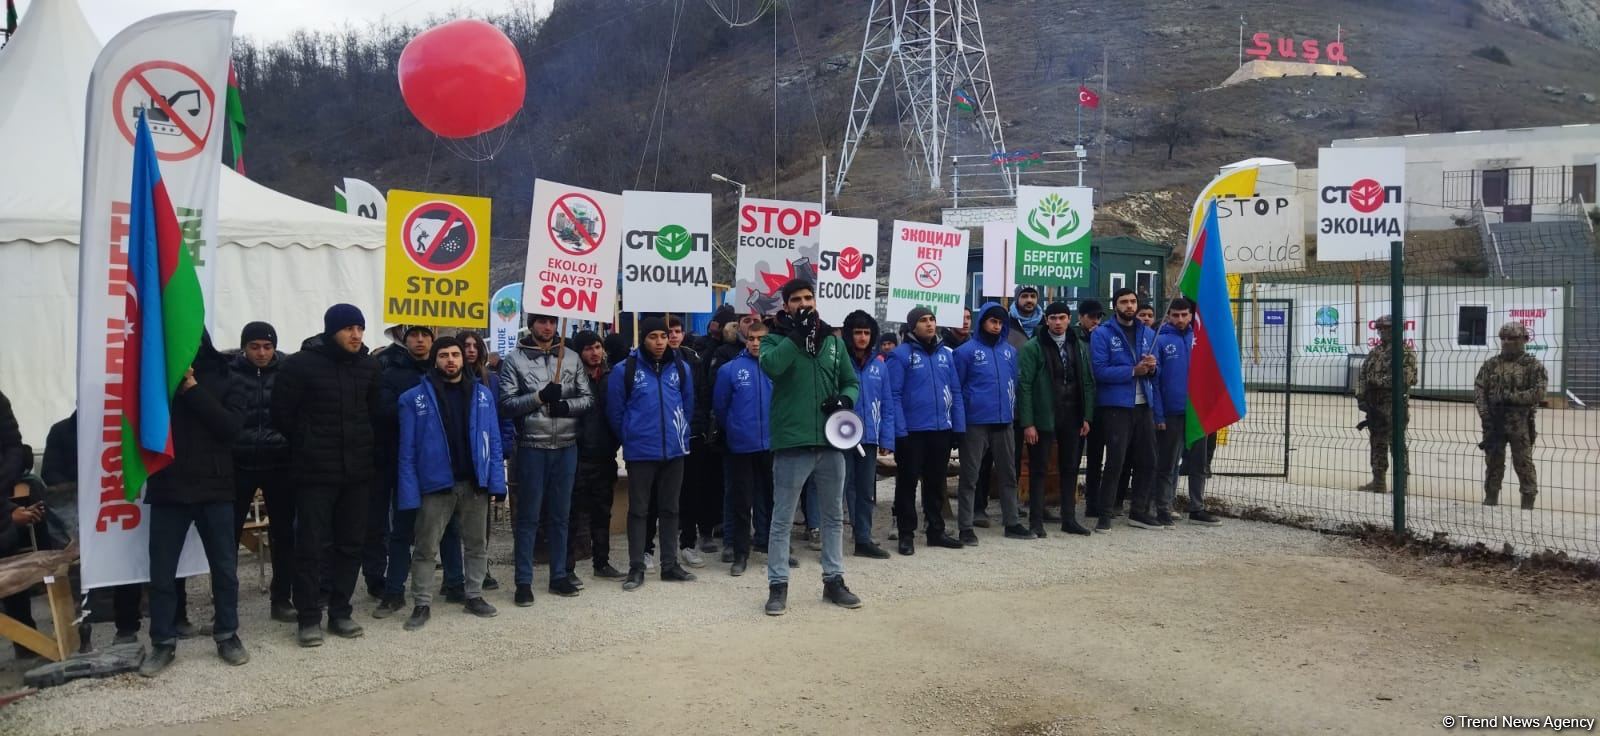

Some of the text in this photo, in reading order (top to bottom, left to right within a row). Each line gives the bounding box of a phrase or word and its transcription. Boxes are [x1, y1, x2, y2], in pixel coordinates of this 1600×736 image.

[1216, 198, 1289, 218] STOP
[741, 204, 821, 236] STOP
[1320, 217, 1402, 237] ЭКОЦИД
[739, 235, 796, 250] ECOCIDE
[901, 227, 962, 249] ЭКОЦИДУ
[1223, 233, 1301, 262] cocide
[917, 246, 943, 261] НЕТ!
[1024, 249, 1084, 264] БЕРЕГИТЕ
[625, 264, 709, 287] ЭКОЦИД
[1022, 264, 1084, 280] ПРИРОДУ!
[406, 276, 469, 296] STOP
[818, 281, 872, 300] ECOCIDE
[892, 287, 961, 304] МОНИТОРИНГУ
[390, 297, 484, 319] MINING
[541, 284, 598, 313] SON
[1314, 337, 1339, 345] SAVE
